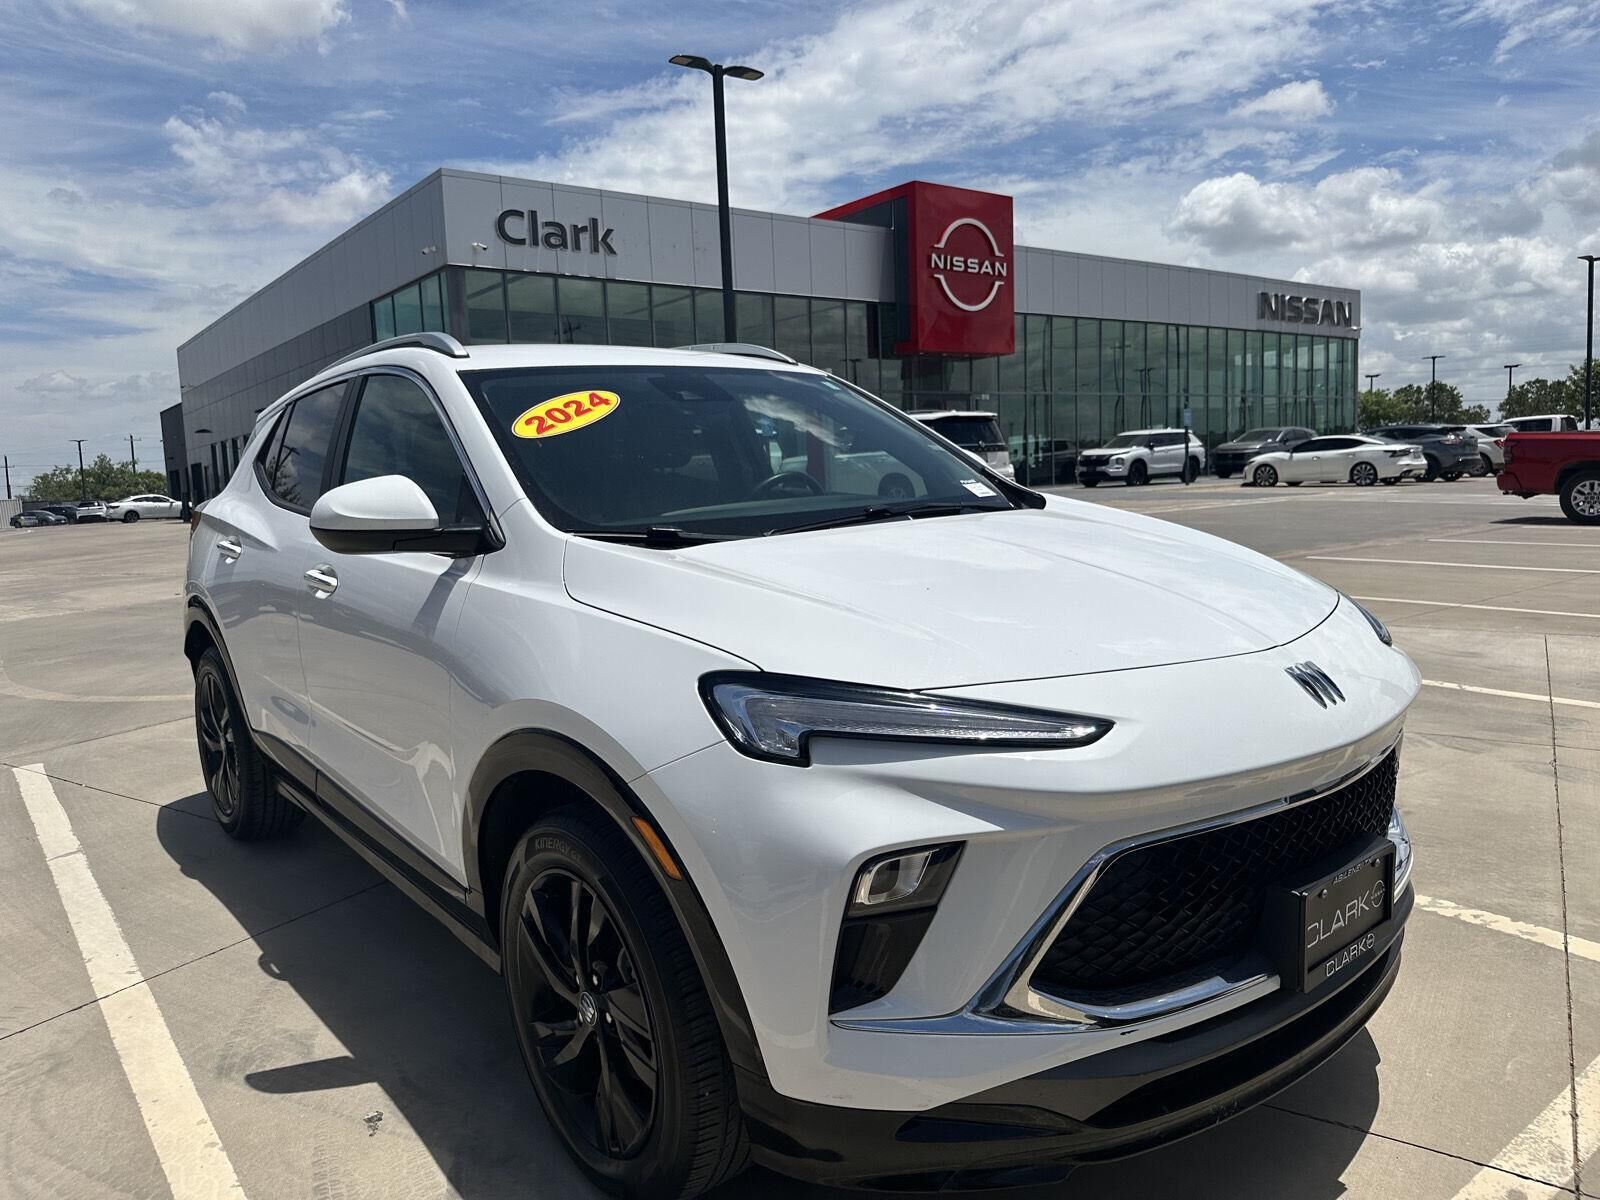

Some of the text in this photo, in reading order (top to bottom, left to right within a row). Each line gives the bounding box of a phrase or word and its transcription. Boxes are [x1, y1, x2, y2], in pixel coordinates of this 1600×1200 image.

[496, 209, 617, 256] Clark
[931, 253, 1007, 277] NISSAN
[1258, 291, 1352, 328] NISSAN
[524, 392, 611, 435] 2024
[1307, 890, 1369, 948] CLARK
[1326, 937, 1367, 977] CLARK
